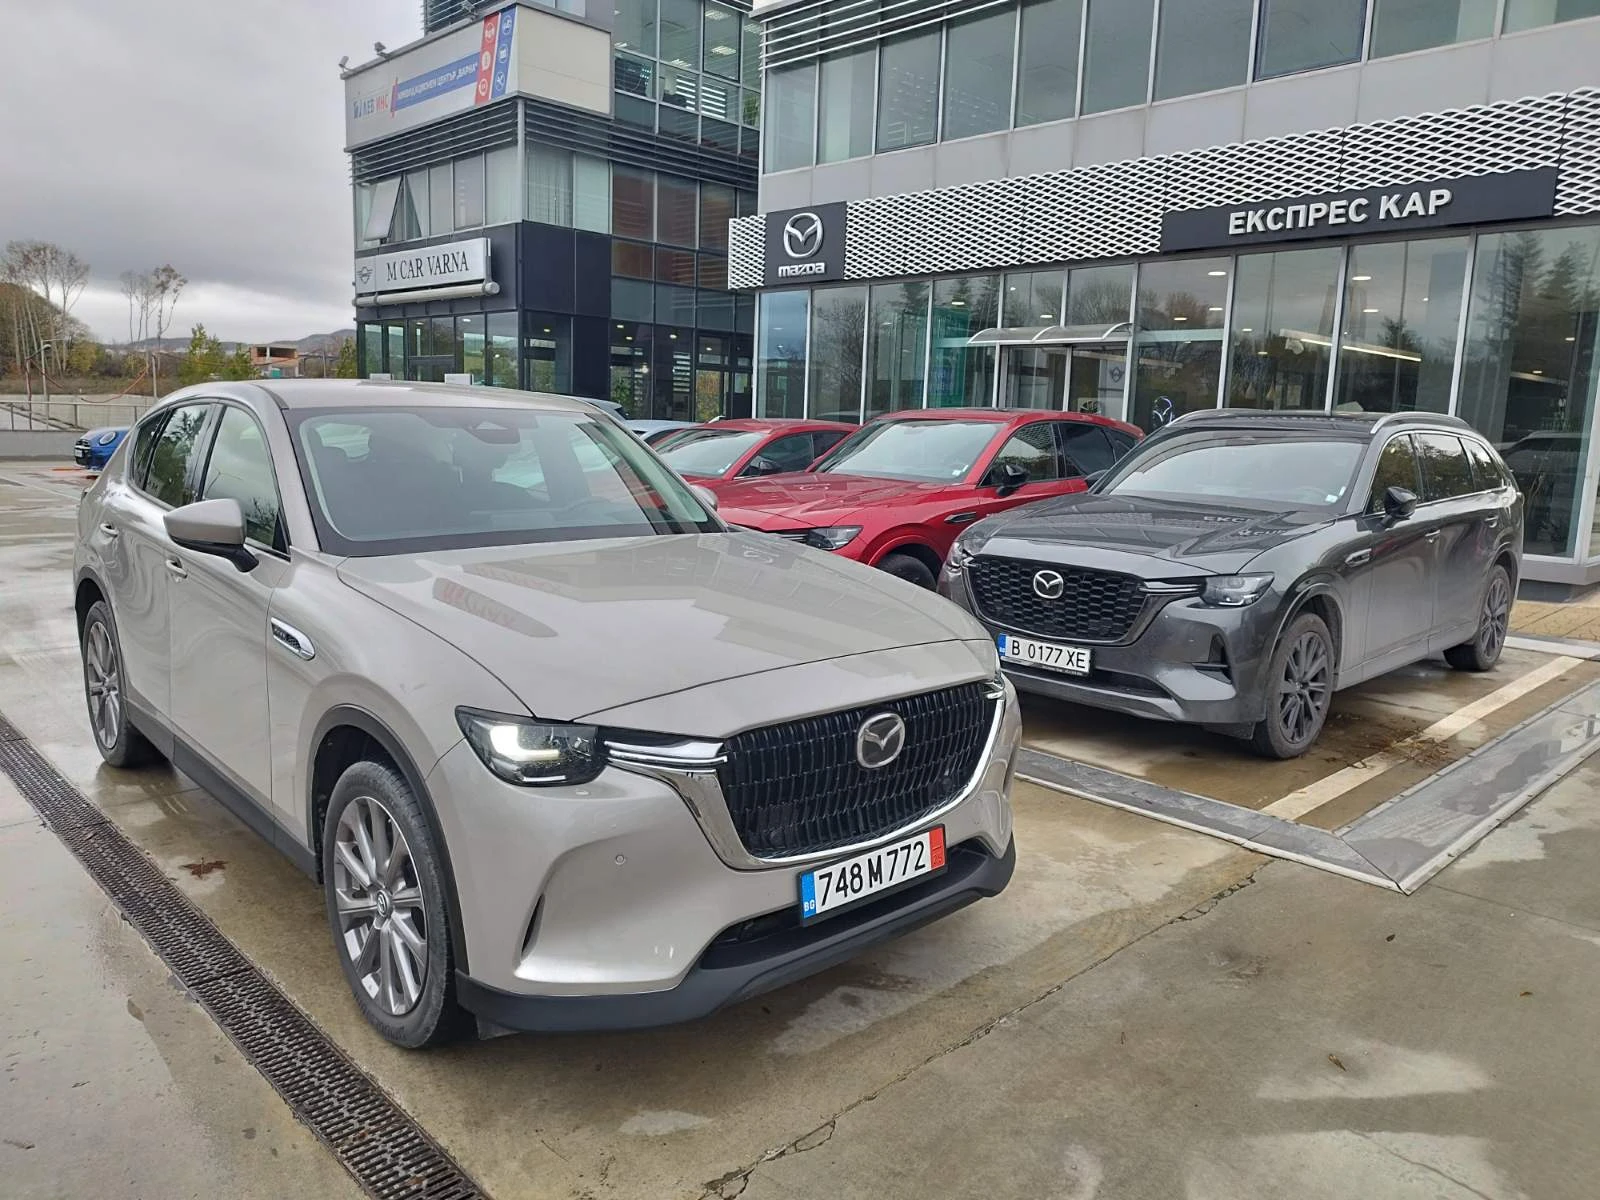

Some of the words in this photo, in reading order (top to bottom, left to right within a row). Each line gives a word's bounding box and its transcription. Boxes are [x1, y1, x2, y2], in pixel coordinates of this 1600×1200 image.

[1228, 197, 1369, 235] ЕКСПРЕС
[1379, 188, 1452, 220] КАР
[386, 262, 398, 281] M
[399, 257, 425, 279] CAR
[427, 250, 470, 276] VARNA
[778, 262, 826, 277] mazda
[1011, 640, 1021, 656] B
[1027, 643, 1063, 664] 0177
[1066, 650, 1086, 669] XE
[803, 899, 816, 912] BG
